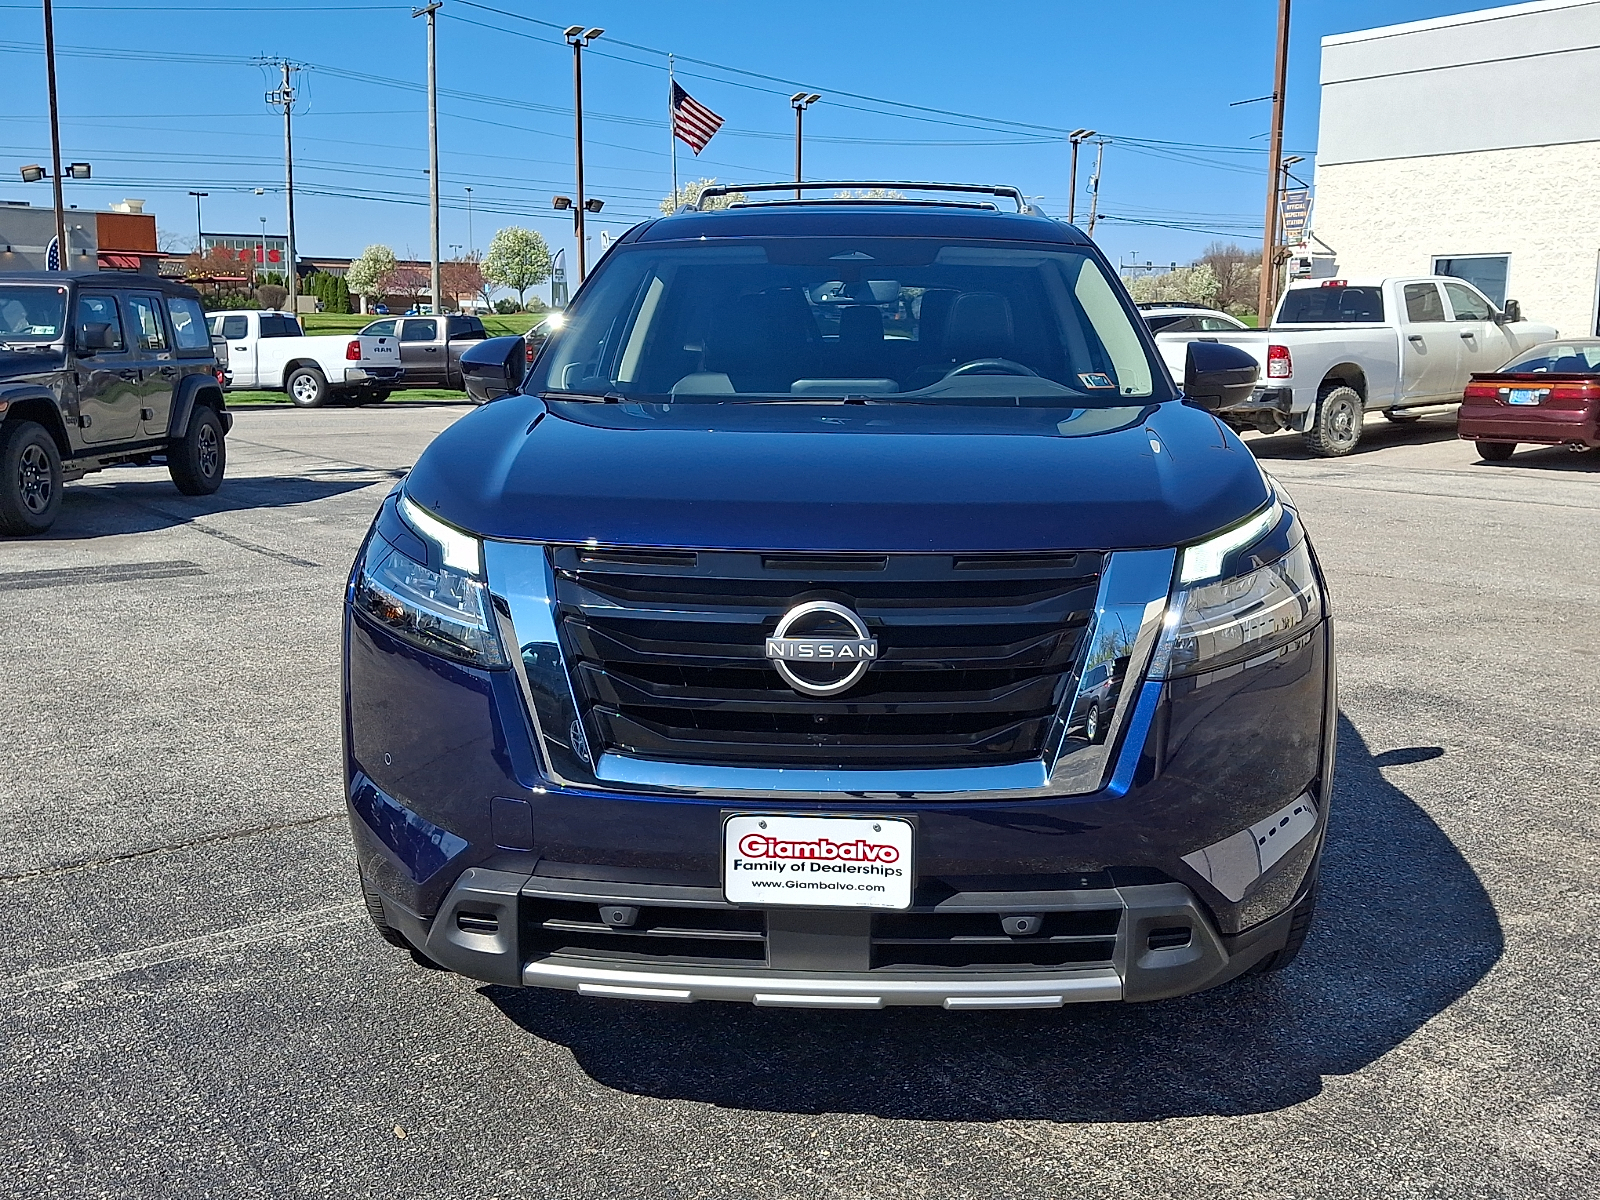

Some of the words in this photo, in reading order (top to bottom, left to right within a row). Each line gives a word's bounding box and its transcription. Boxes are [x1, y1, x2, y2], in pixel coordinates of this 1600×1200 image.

[768, 642, 876, 658] NISSAN
[739, 833, 900, 864] Giambalvo
[733, 859, 787, 874] Family
[790, 861, 806, 873] of
[810, 862, 903, 878] Dealerships
[751, 880, 886, 893] www.Giambalvo.com
